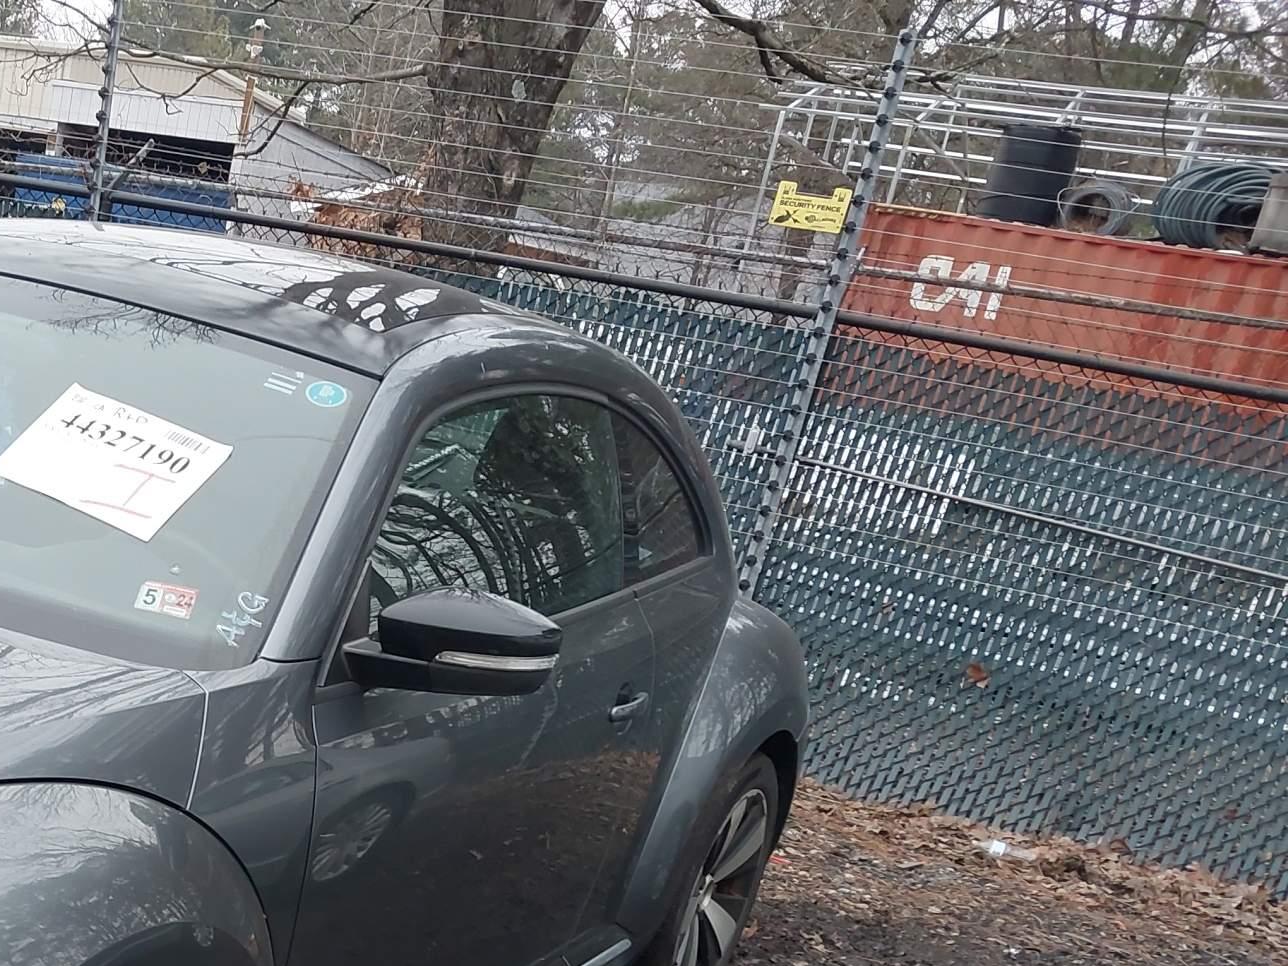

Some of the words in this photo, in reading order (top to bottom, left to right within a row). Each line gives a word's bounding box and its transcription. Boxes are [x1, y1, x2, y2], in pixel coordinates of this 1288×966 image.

[779, 199, 816, 210] SECURITY
[816, 204, 841, 213] FENCE
[60, 414, 190, 474] 44327190
[143, 588, 158, 605] 5
[175, 593, 193, 609] 24
